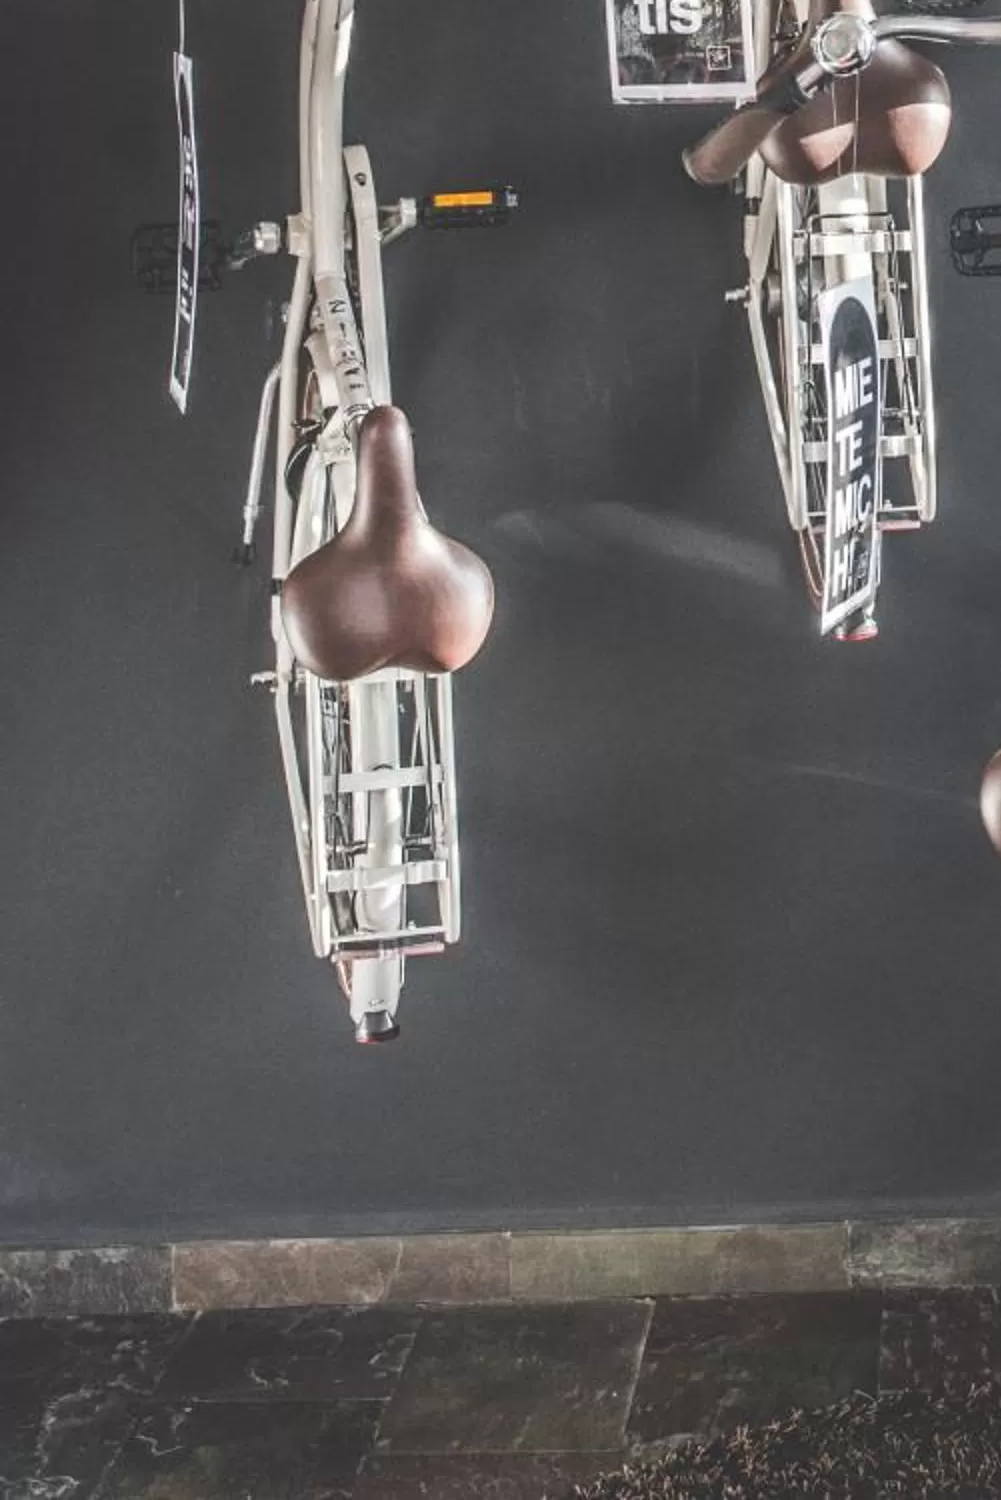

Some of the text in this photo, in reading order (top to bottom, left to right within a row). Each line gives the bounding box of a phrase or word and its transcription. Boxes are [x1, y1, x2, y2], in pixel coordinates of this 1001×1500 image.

[834, 357, 873, 419] MIE
[835, 420, 863, 477] TE
[835, 474, 872, 538] MIC
